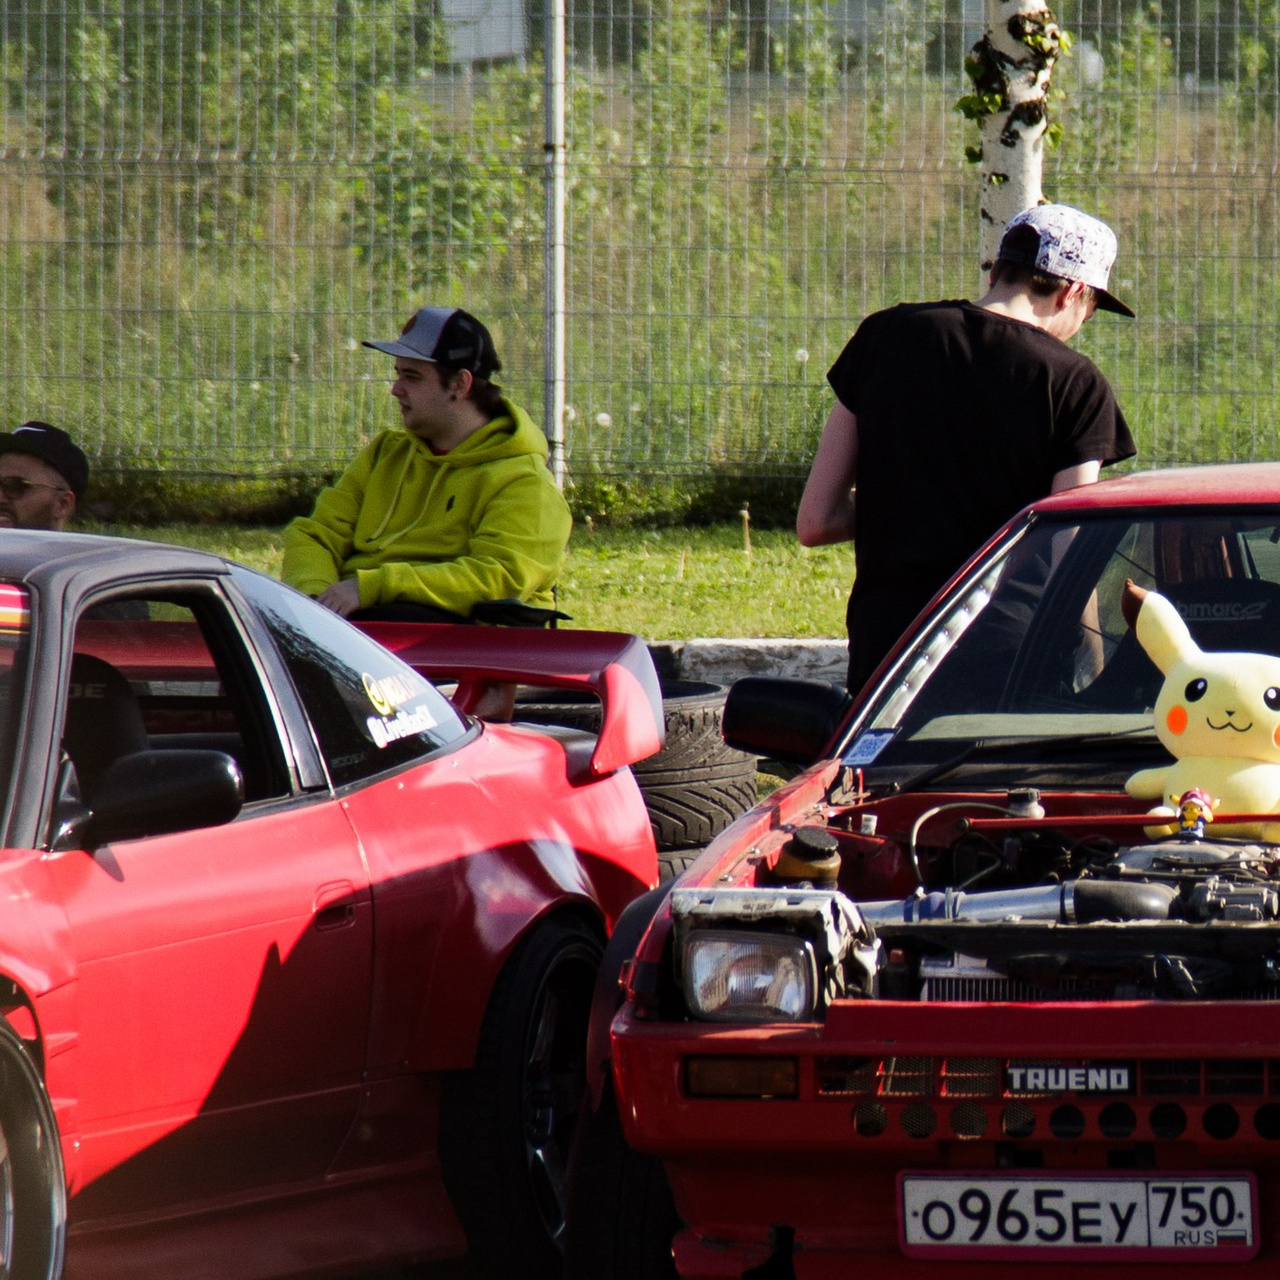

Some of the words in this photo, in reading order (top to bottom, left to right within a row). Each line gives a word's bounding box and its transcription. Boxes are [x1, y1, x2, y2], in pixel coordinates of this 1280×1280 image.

[1007, 1067, 1129, 1091] TRUENO
[1151, 1186, 1235, 1228] 750
[1174, 1230, 1215, 1245] RUS
